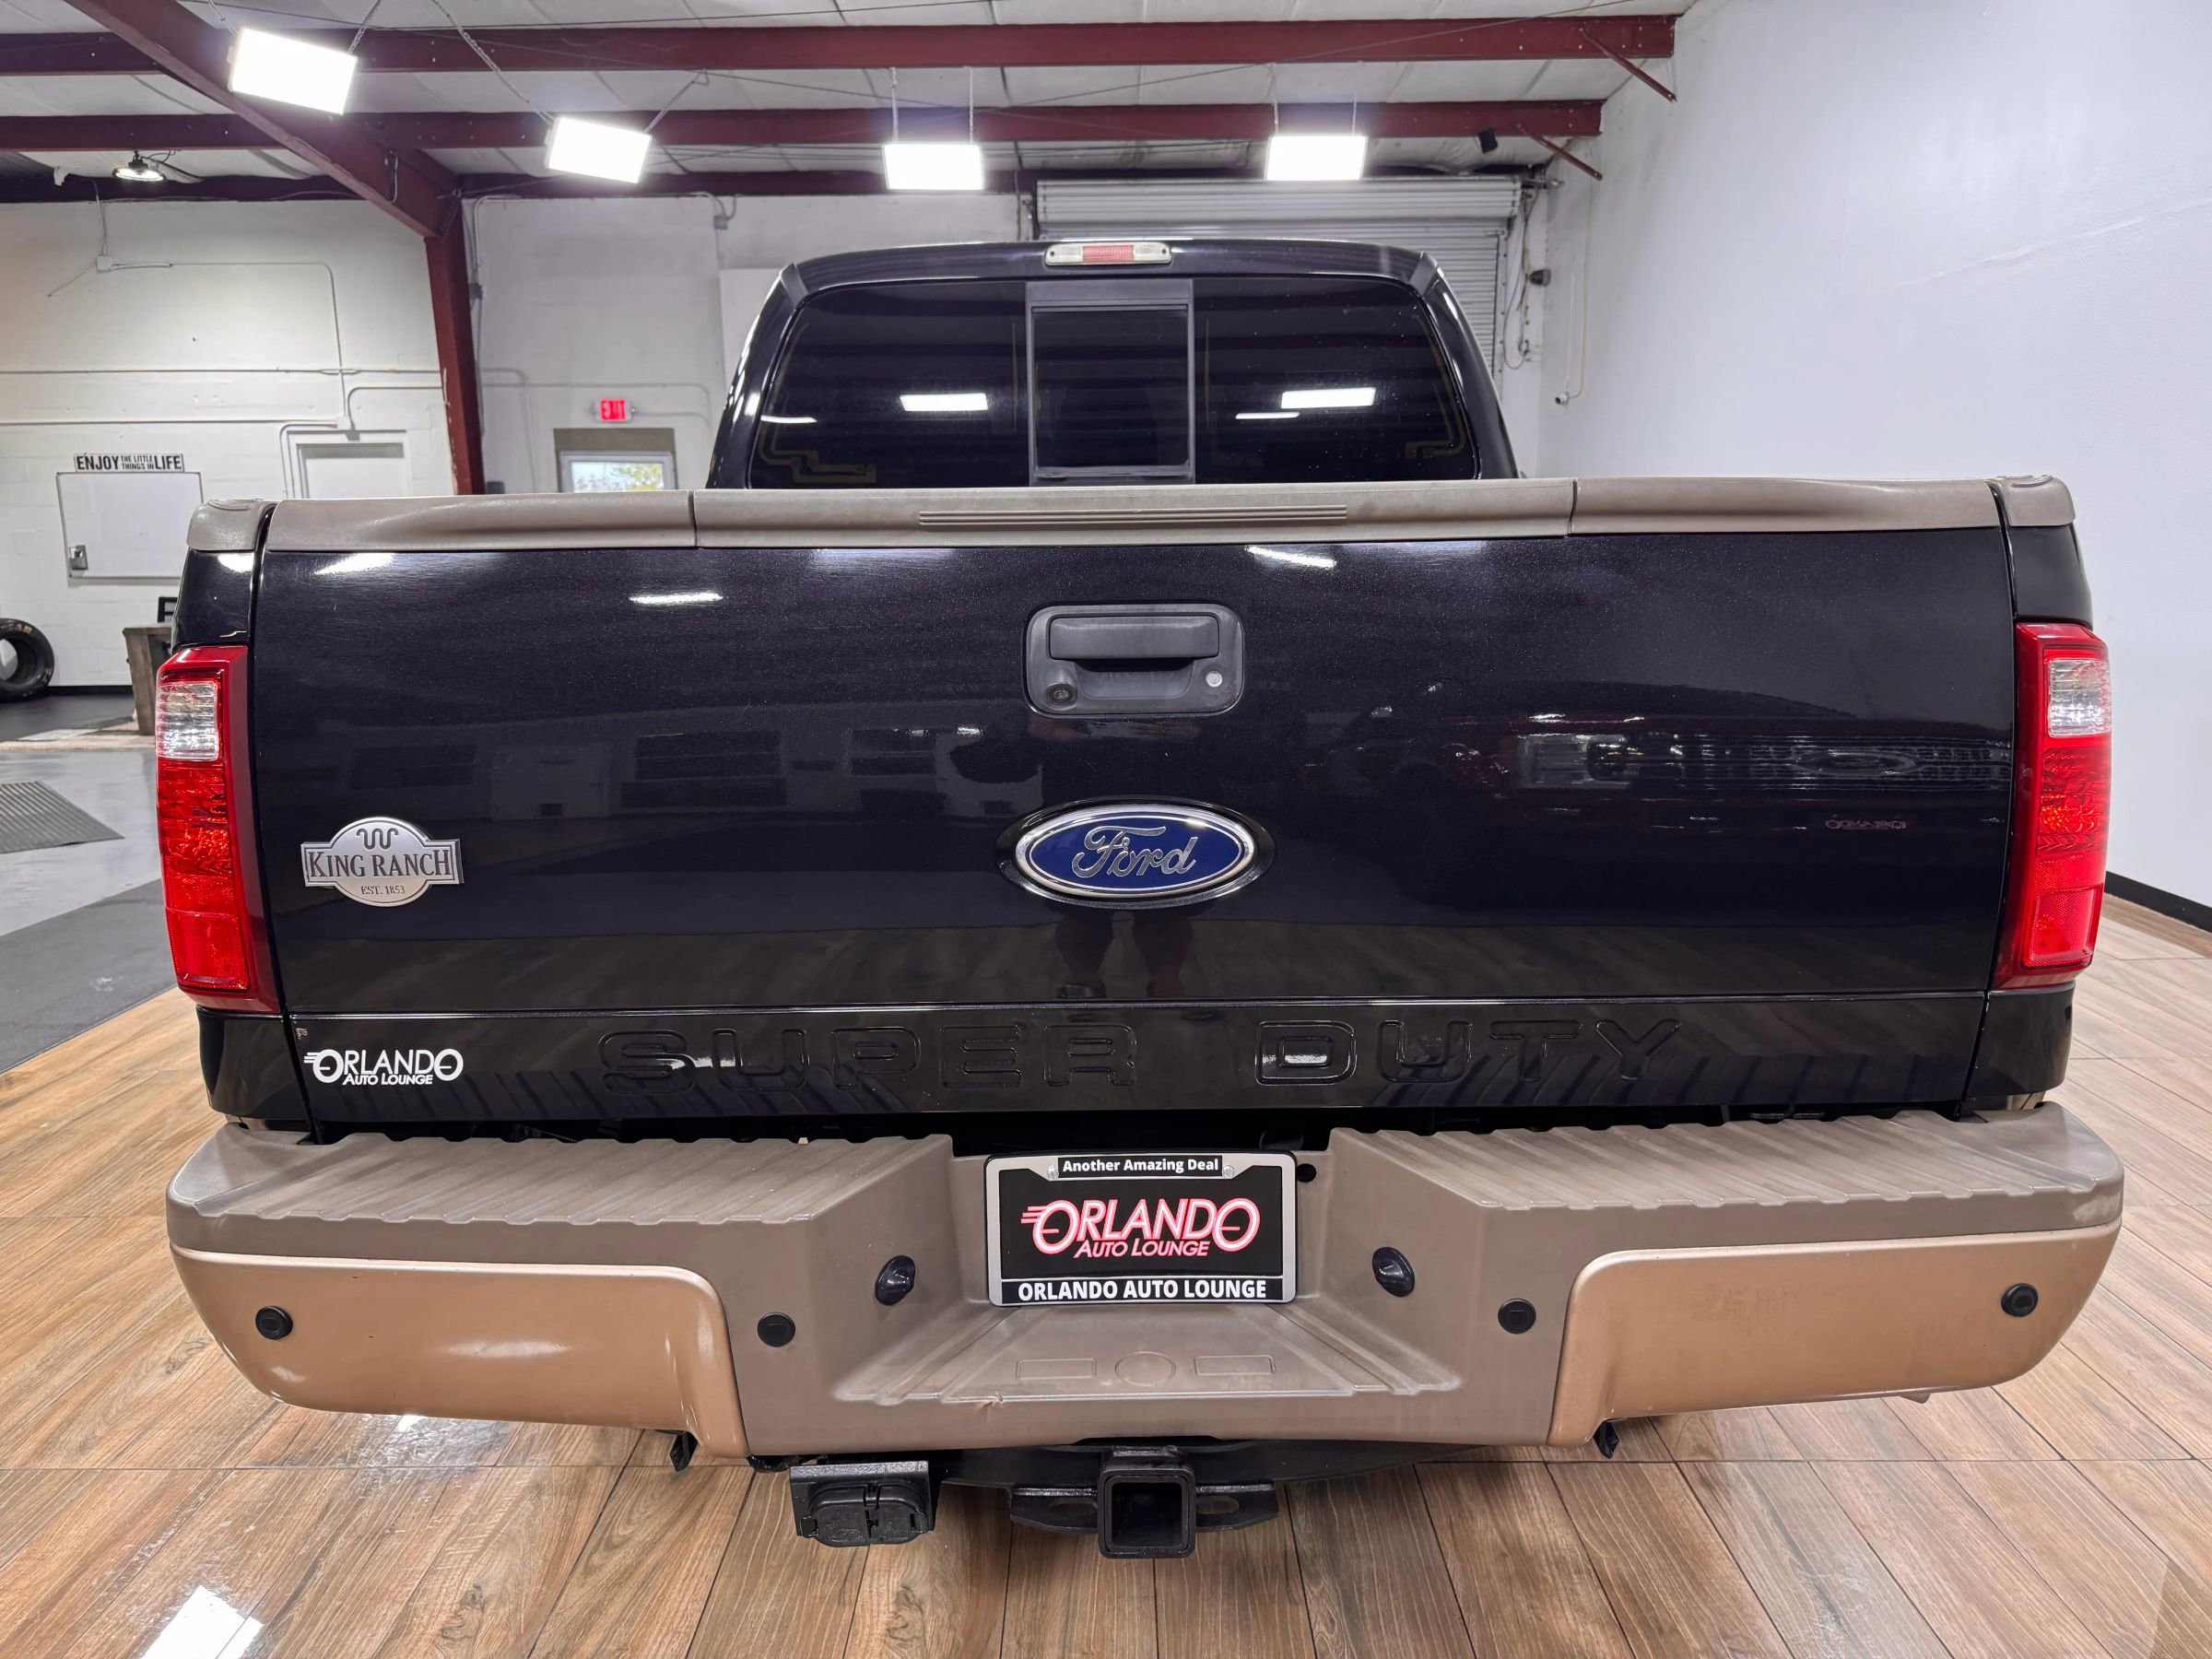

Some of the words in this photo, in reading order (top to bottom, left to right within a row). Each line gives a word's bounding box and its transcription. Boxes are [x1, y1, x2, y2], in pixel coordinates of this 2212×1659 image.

[76, 455, 119, 470] ENJOY
[154, 455, 182, 470] LIFE
[1071, 825, 1198, 878] Ford
[308, 851, 364, 877] KING
[371, 849, 453, 877] RANCH
[360, 886, 382, 895] EST.
[385, 885, 406, 895] 1853
[304, 1049, 464, 1083] ORLANDO
[598, 1025, 1137, 1095] SUPER
[1255, 1018, 1682, 1087] DUTY
[342, 1074, 379, 1085] AUTO
[381, 1073, 433, 1085] LOUNGE
[1063, 1159, 1120, 1172] Another
[1123, 1159, 1184, 1173] Amazing
[1187, 1159, 1218, 1171] Deal
[1020, 1198, 1261, 1254] ORLANDO
[1074, 1240, 1128, 1258] AUTO
[1131, 1238, 1210, 1257] LOUNGE
[1018, 1281, 1118, 1301] ORLANDO
[1123, 1280, 1178, 1299] AUTO
[1184, 1279, 1266, 1299] LOUNGE
